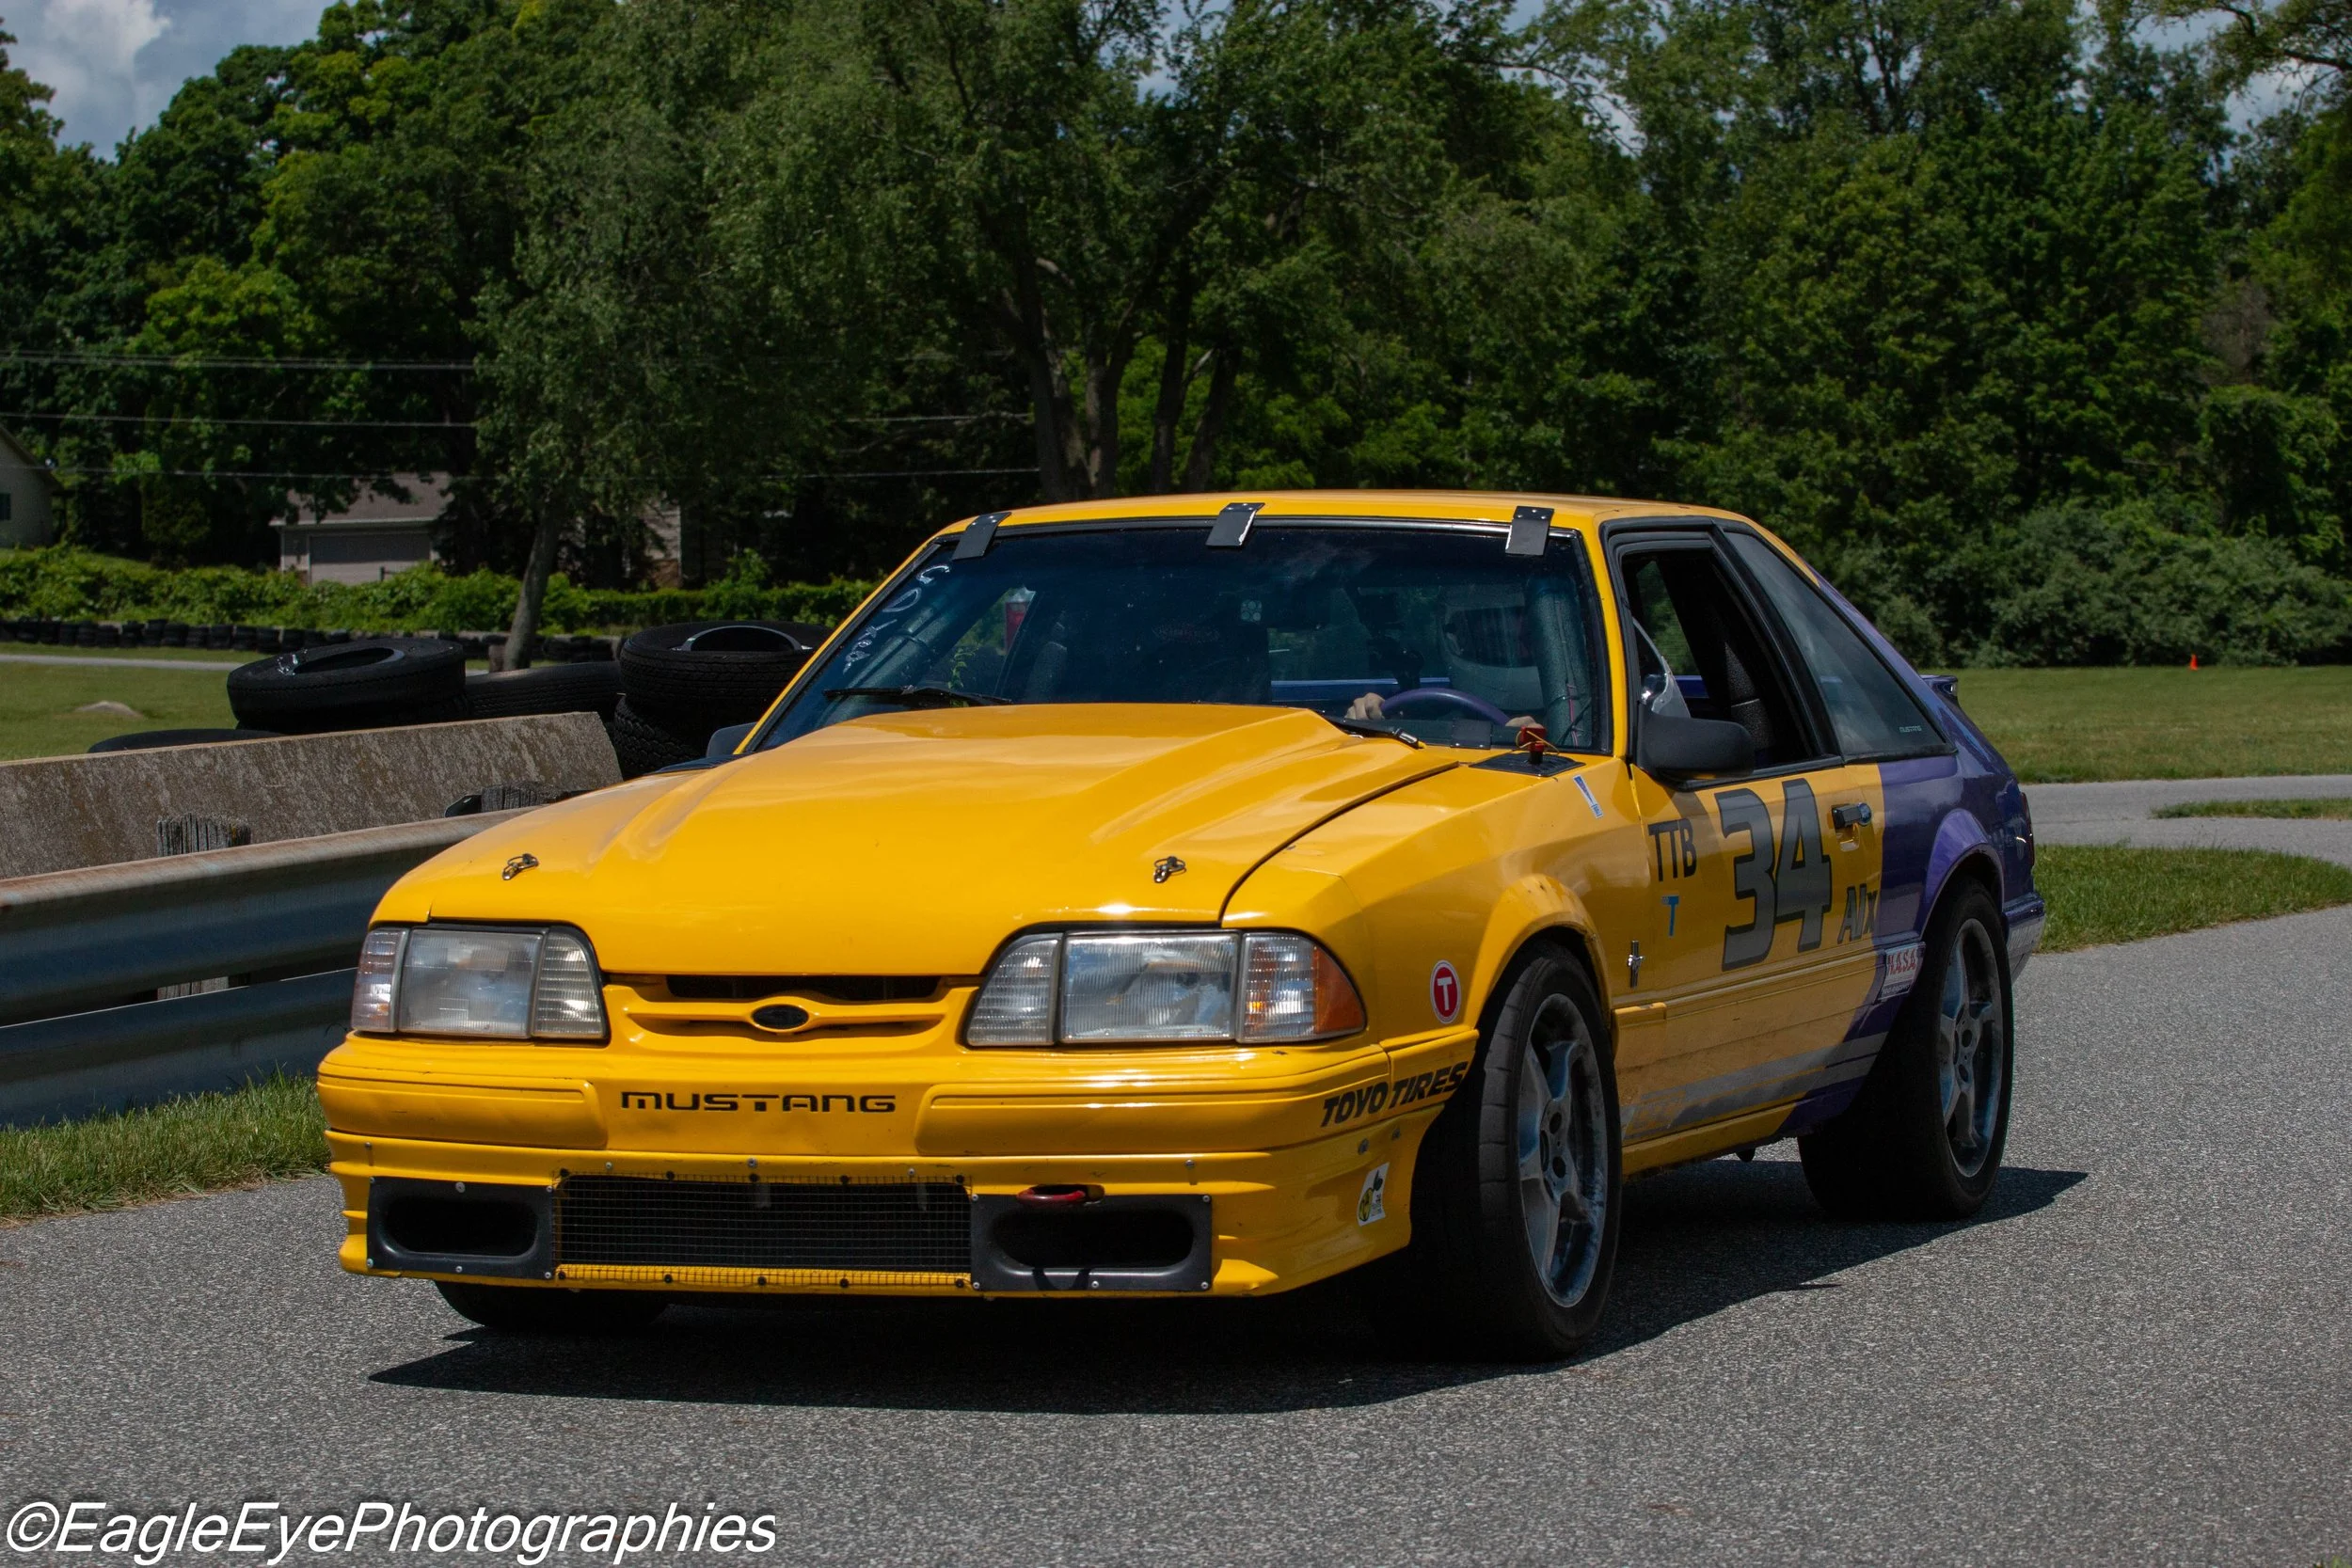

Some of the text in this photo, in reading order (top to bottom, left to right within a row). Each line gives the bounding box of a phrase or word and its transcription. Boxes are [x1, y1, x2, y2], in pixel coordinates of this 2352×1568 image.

[1648, 818, 1697, 881] TTB
[1714, 778, 1833, 972] 34
[1887, 948, 1917, 974] NASA
[1437, 976, 1453, 1011] T
[621, 1091, 896, 1112] MUSTANG
[1320, 1061, 1469, 1128] TOYO TIRES
